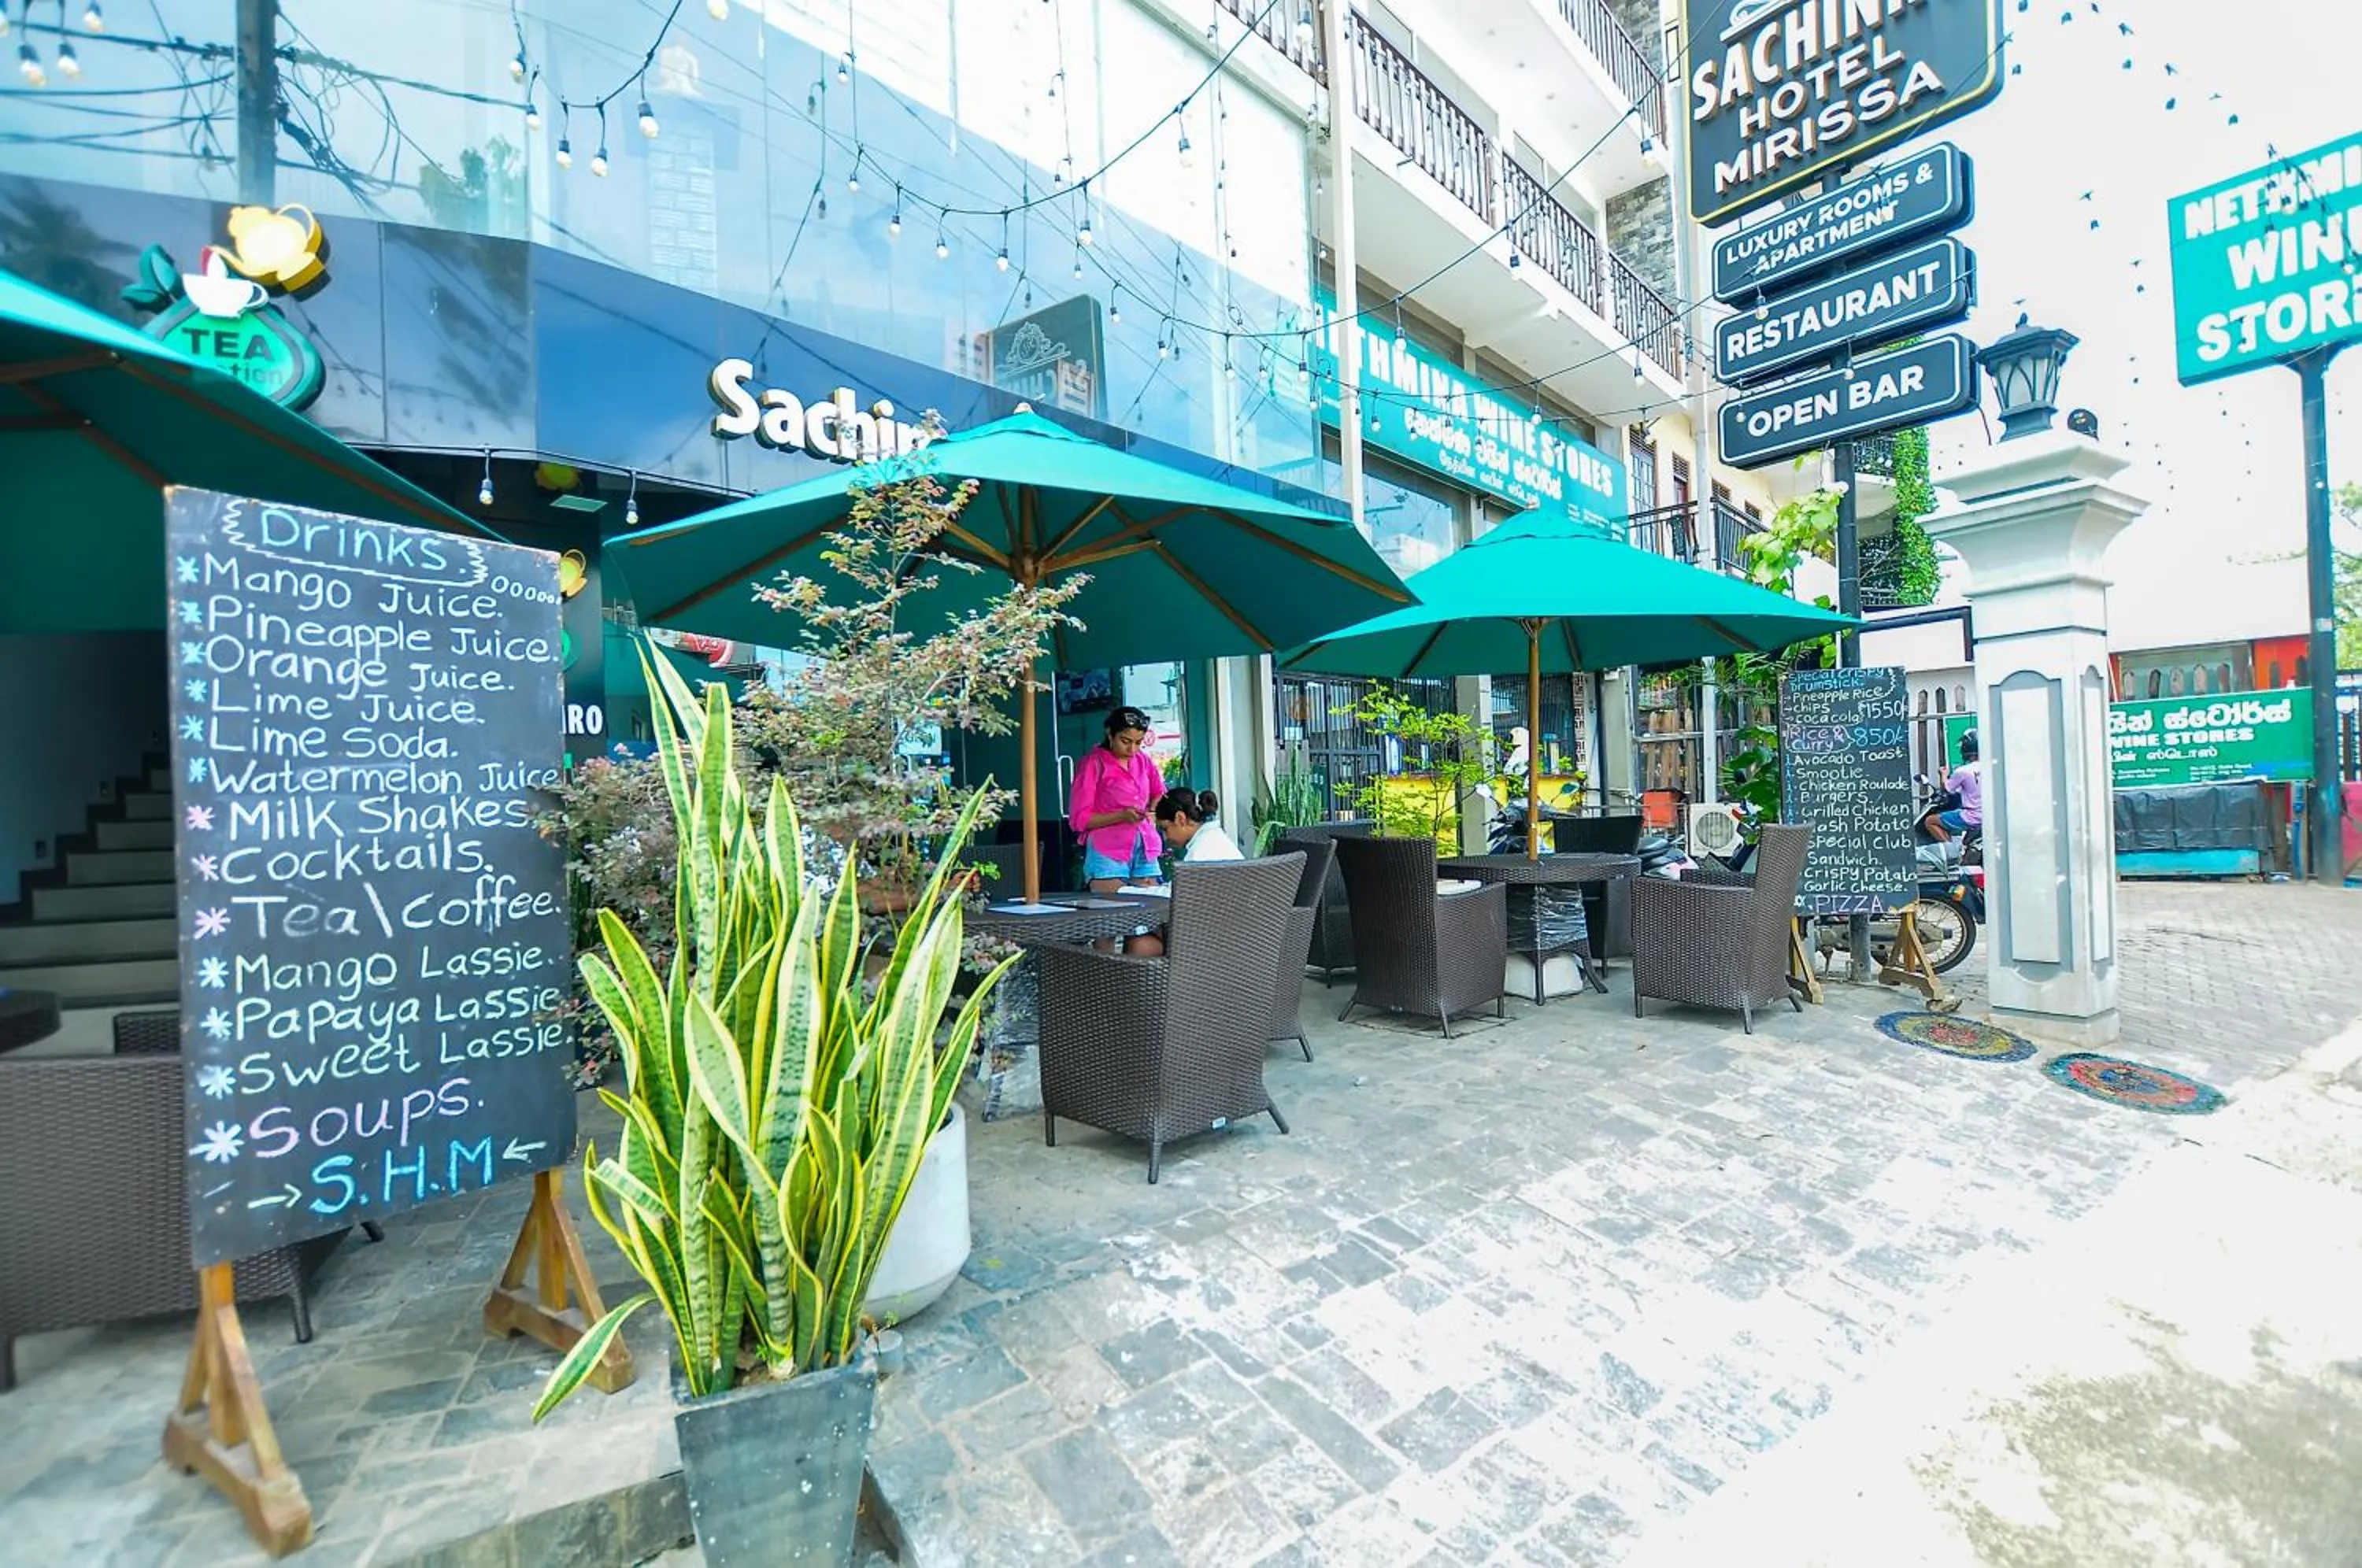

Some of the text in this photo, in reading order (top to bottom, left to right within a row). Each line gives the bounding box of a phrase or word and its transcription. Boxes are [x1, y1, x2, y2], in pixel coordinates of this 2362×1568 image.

[1693, 0, 1921, 121] SACHIN
[1739, 35, 1905, 139] HOTEL
[1713, 61, 1946, 195] MIRISSA
[1727, 162, 1934, 265] LUXURY ROOMS &
[1754, 200, 1899, 275] APARTMENT
[1727, 261, 1941, 362] RESTAURANT
[181, 327, 276, 363] TEA
[217, 363, 283, 384] tion
[1747, 365, 1924, 438] OPEN BAR
[1474, 393, 1538, 459] WINE
[1540, 431, 1613, 497] STORES
[205, 553, 504, 619] Mango Juice.
[209, 595, 560, 664] Pineapple Juice.
[206, 634, 515, 699] Orange Juice.
[212, 679, 485, 725] Lime Juice.
[1853, 686, 1883, 700] Rice
[209, 717, 459, 760] Lime Soda.
[561, 704, 604, 735] RO
[1790, 725, 1829, 739] Rice
[2163, 727, 2255, 746] STORES
[208, 757, 463, 794] Watermelon
[1794, 753, 1855, 766] Avocado
[229, 797, 346, 841] Milk
[1802, 817, 1848, 833] ash
[1852, 801, 1909, 816] Chicken
[220, 831, 494, 884] Cocktails.
[1873, 834, 1912, 849] Club
[1804, 879, 1846, 893] Garlic
[1813, 894, 1884, 914] PIZZA
[235, 941, 554, 1001] Mango Lassie.
[236, 996, 420, 1045] Papaya
[239, 1021, 573, 1096] Sweet Lassie.
[248, 1078, 485, 1159] Soups.
